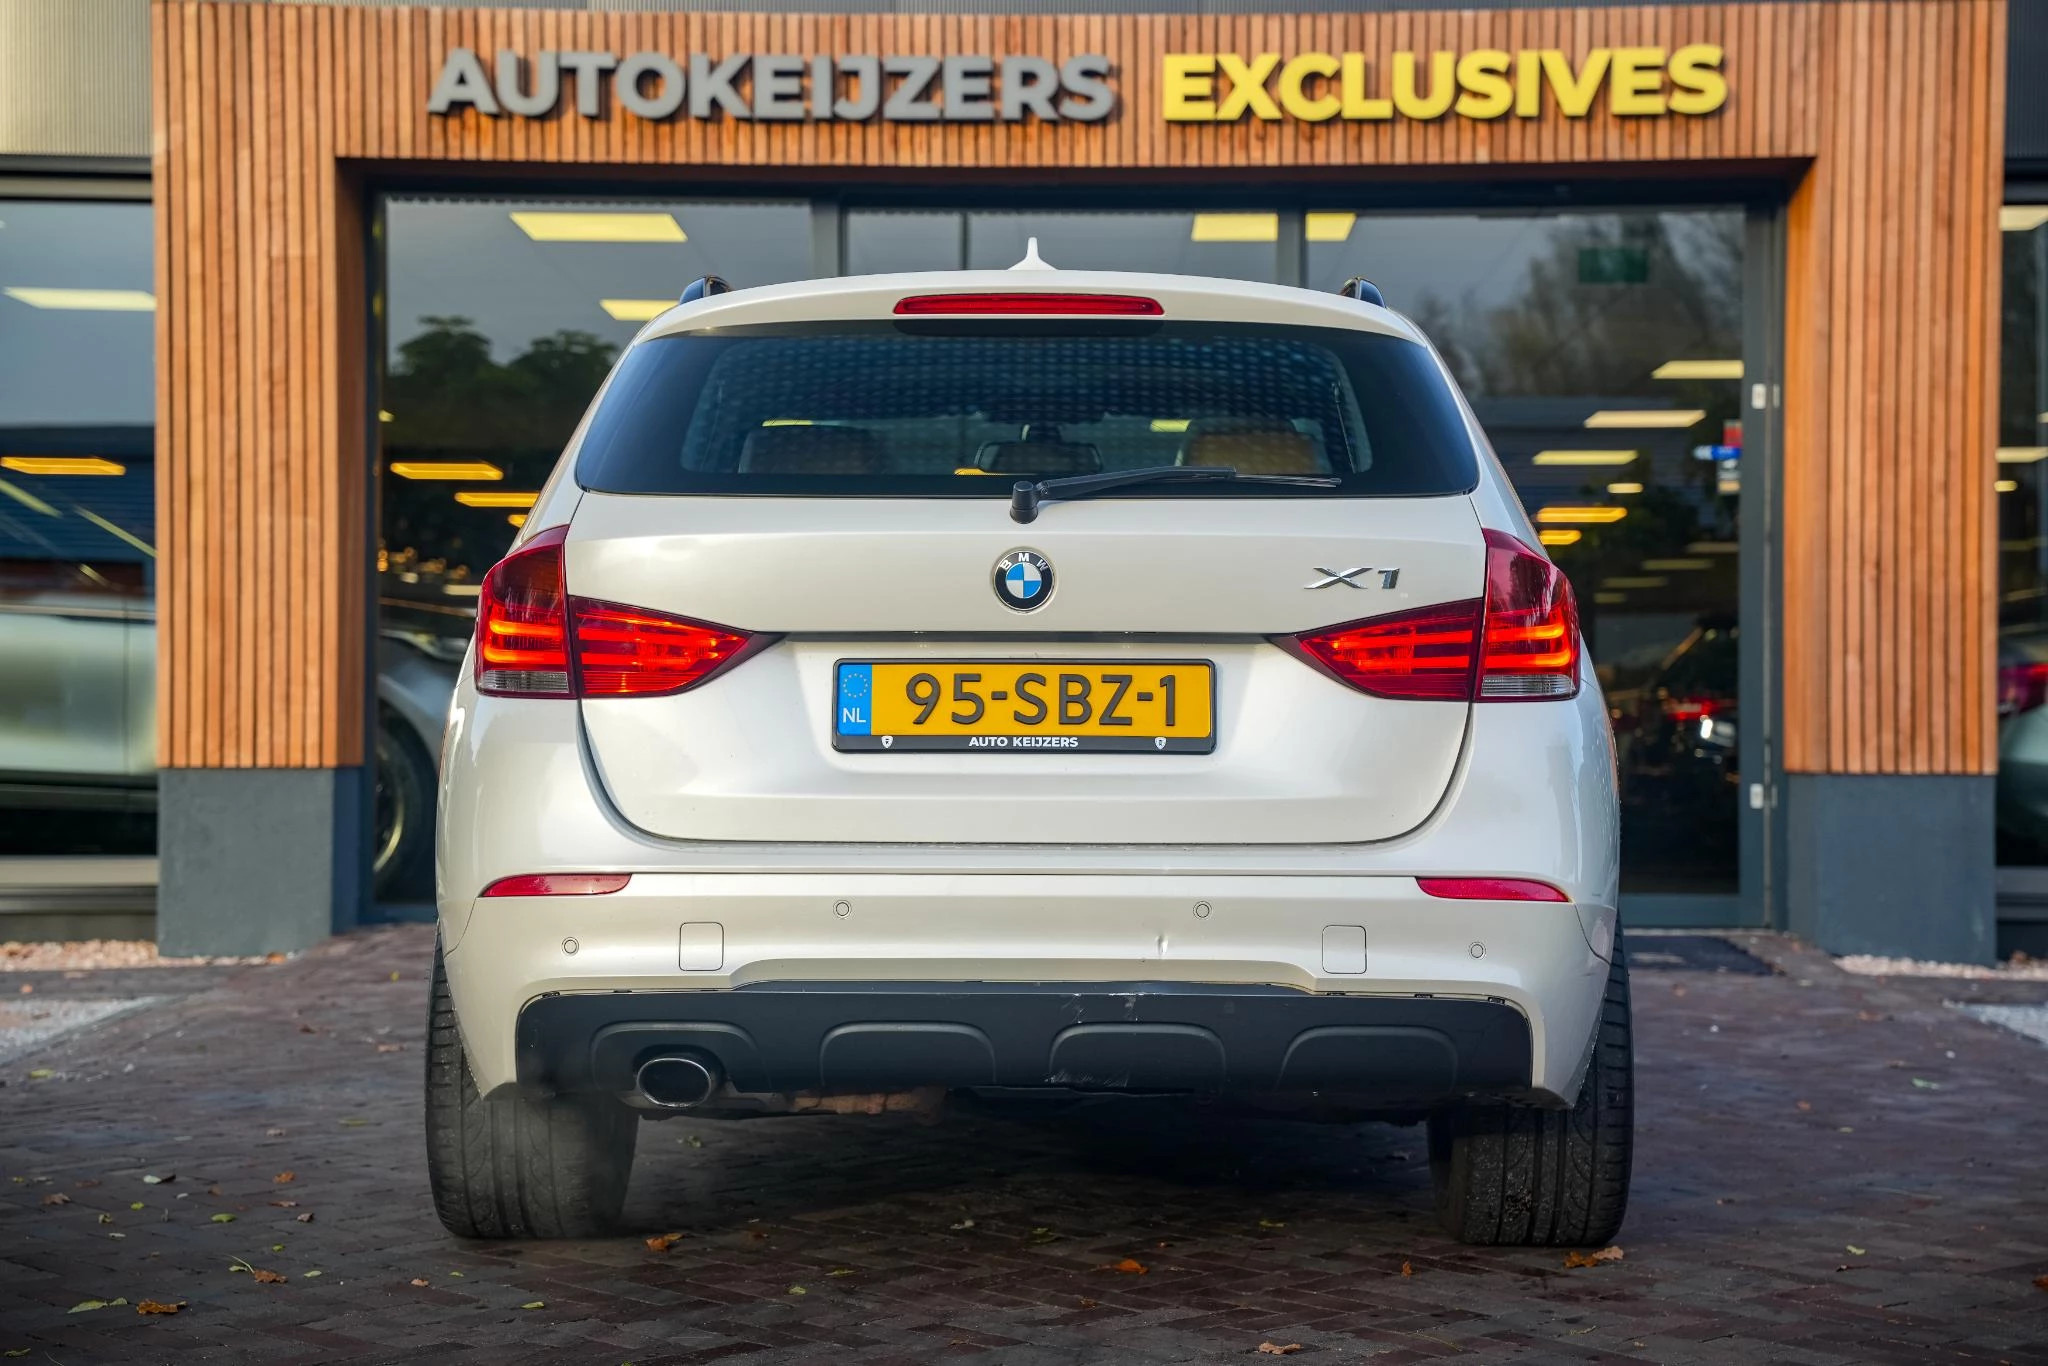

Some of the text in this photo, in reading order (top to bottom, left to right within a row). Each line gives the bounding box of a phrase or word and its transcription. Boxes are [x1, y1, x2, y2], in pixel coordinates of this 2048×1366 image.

[428, 44, 1729, 121] AUTOKEIJZERS EXCLUSIVES
[1000, 553, 1049, 571] BMW
[1303, 567, 1400, 589] X1
[905, 672, 1176, 727] 95-SBZ-1
[842, 707, 867, 723] NL
[968, 736, 1079, 748] AUTO KEIJZERS
